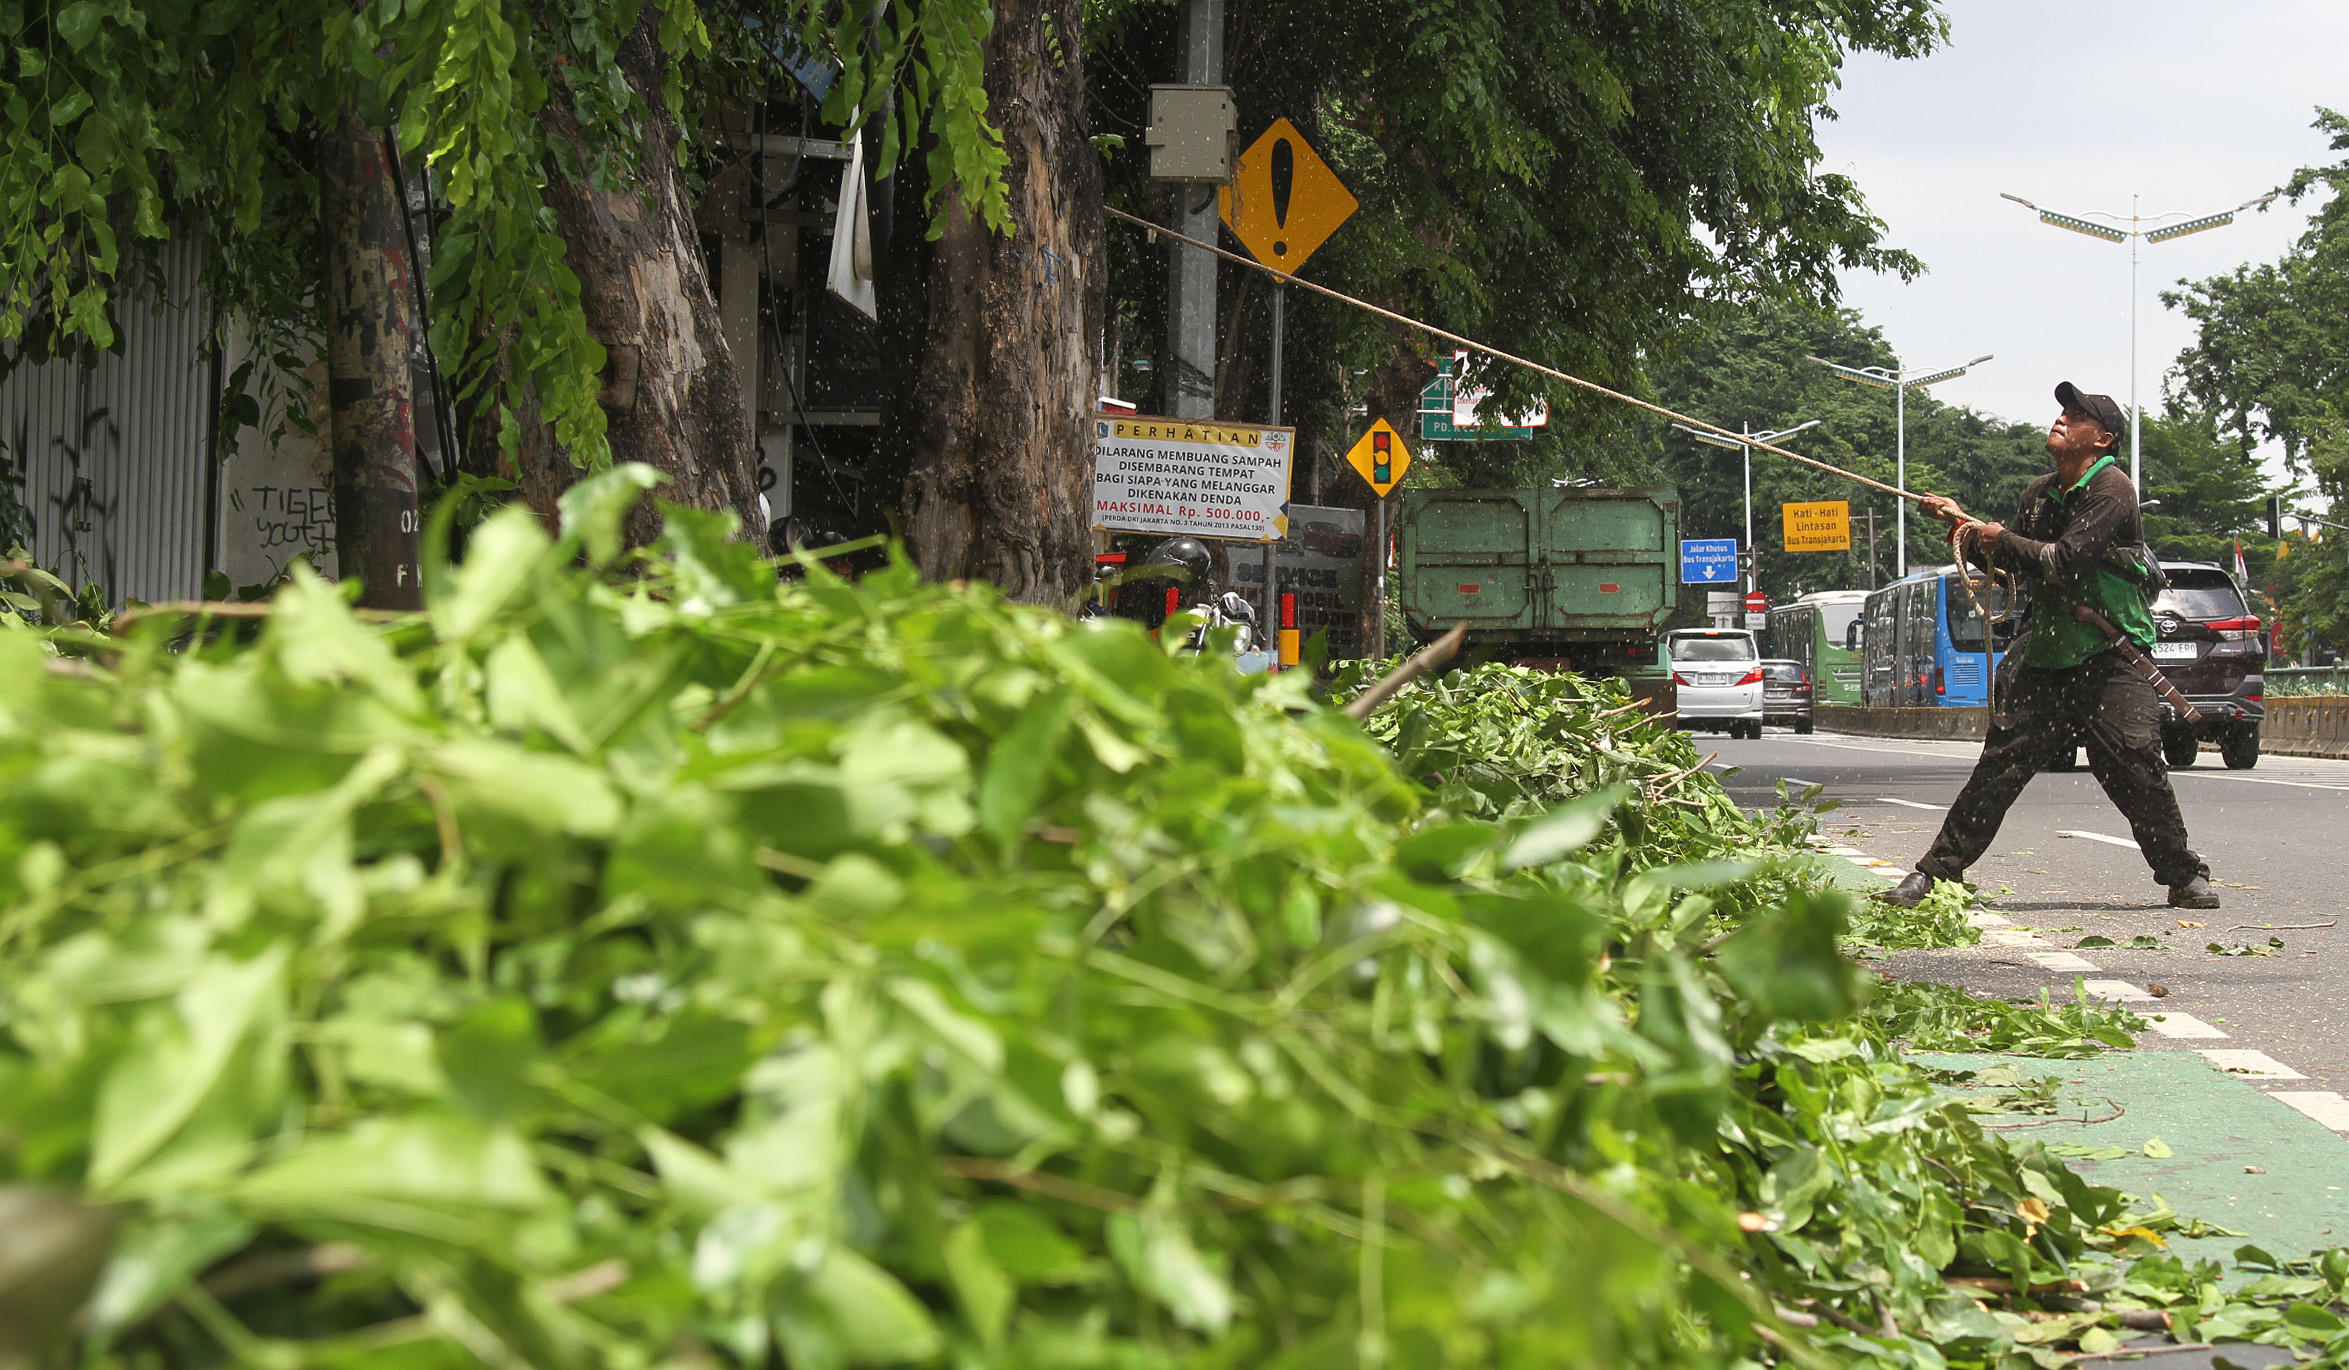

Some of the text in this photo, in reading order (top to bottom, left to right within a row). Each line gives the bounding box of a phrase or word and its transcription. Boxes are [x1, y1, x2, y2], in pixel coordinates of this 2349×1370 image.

[1116, 424, 1259, 445] PERHATIAN
[1096, 446, 1281, 468] DILARANG MEMBUANG SAMPAH
[1119, 461, 1255, 479] DISEMBARANG TEMPAT
[1096, 474, 1276, 494] BAGI SIAPA YANG MELANGGAR
[1128, 488, 1242, 505] DIKENAKAN DENDA
[1096, 500, 1270, 523] MAKSIMAL Rp. 500.000,-
[1793, 508, 1812, 518] Hati
[1820, 507, 1838, 517] Hati
[1101, 514, 1127, 522] (PERDA
[1139, 517, 1169, 525] JAKARTA
[1170, 518, 1183, 526] NO.
[1189, 520, 1213, 528] TAHUN
[1796, 522, 1837, 531] Lintasan
[1787, 535, 1847, 546] Bus Transjakarta
[1695, 554, 1735, 564] Transjakarta
